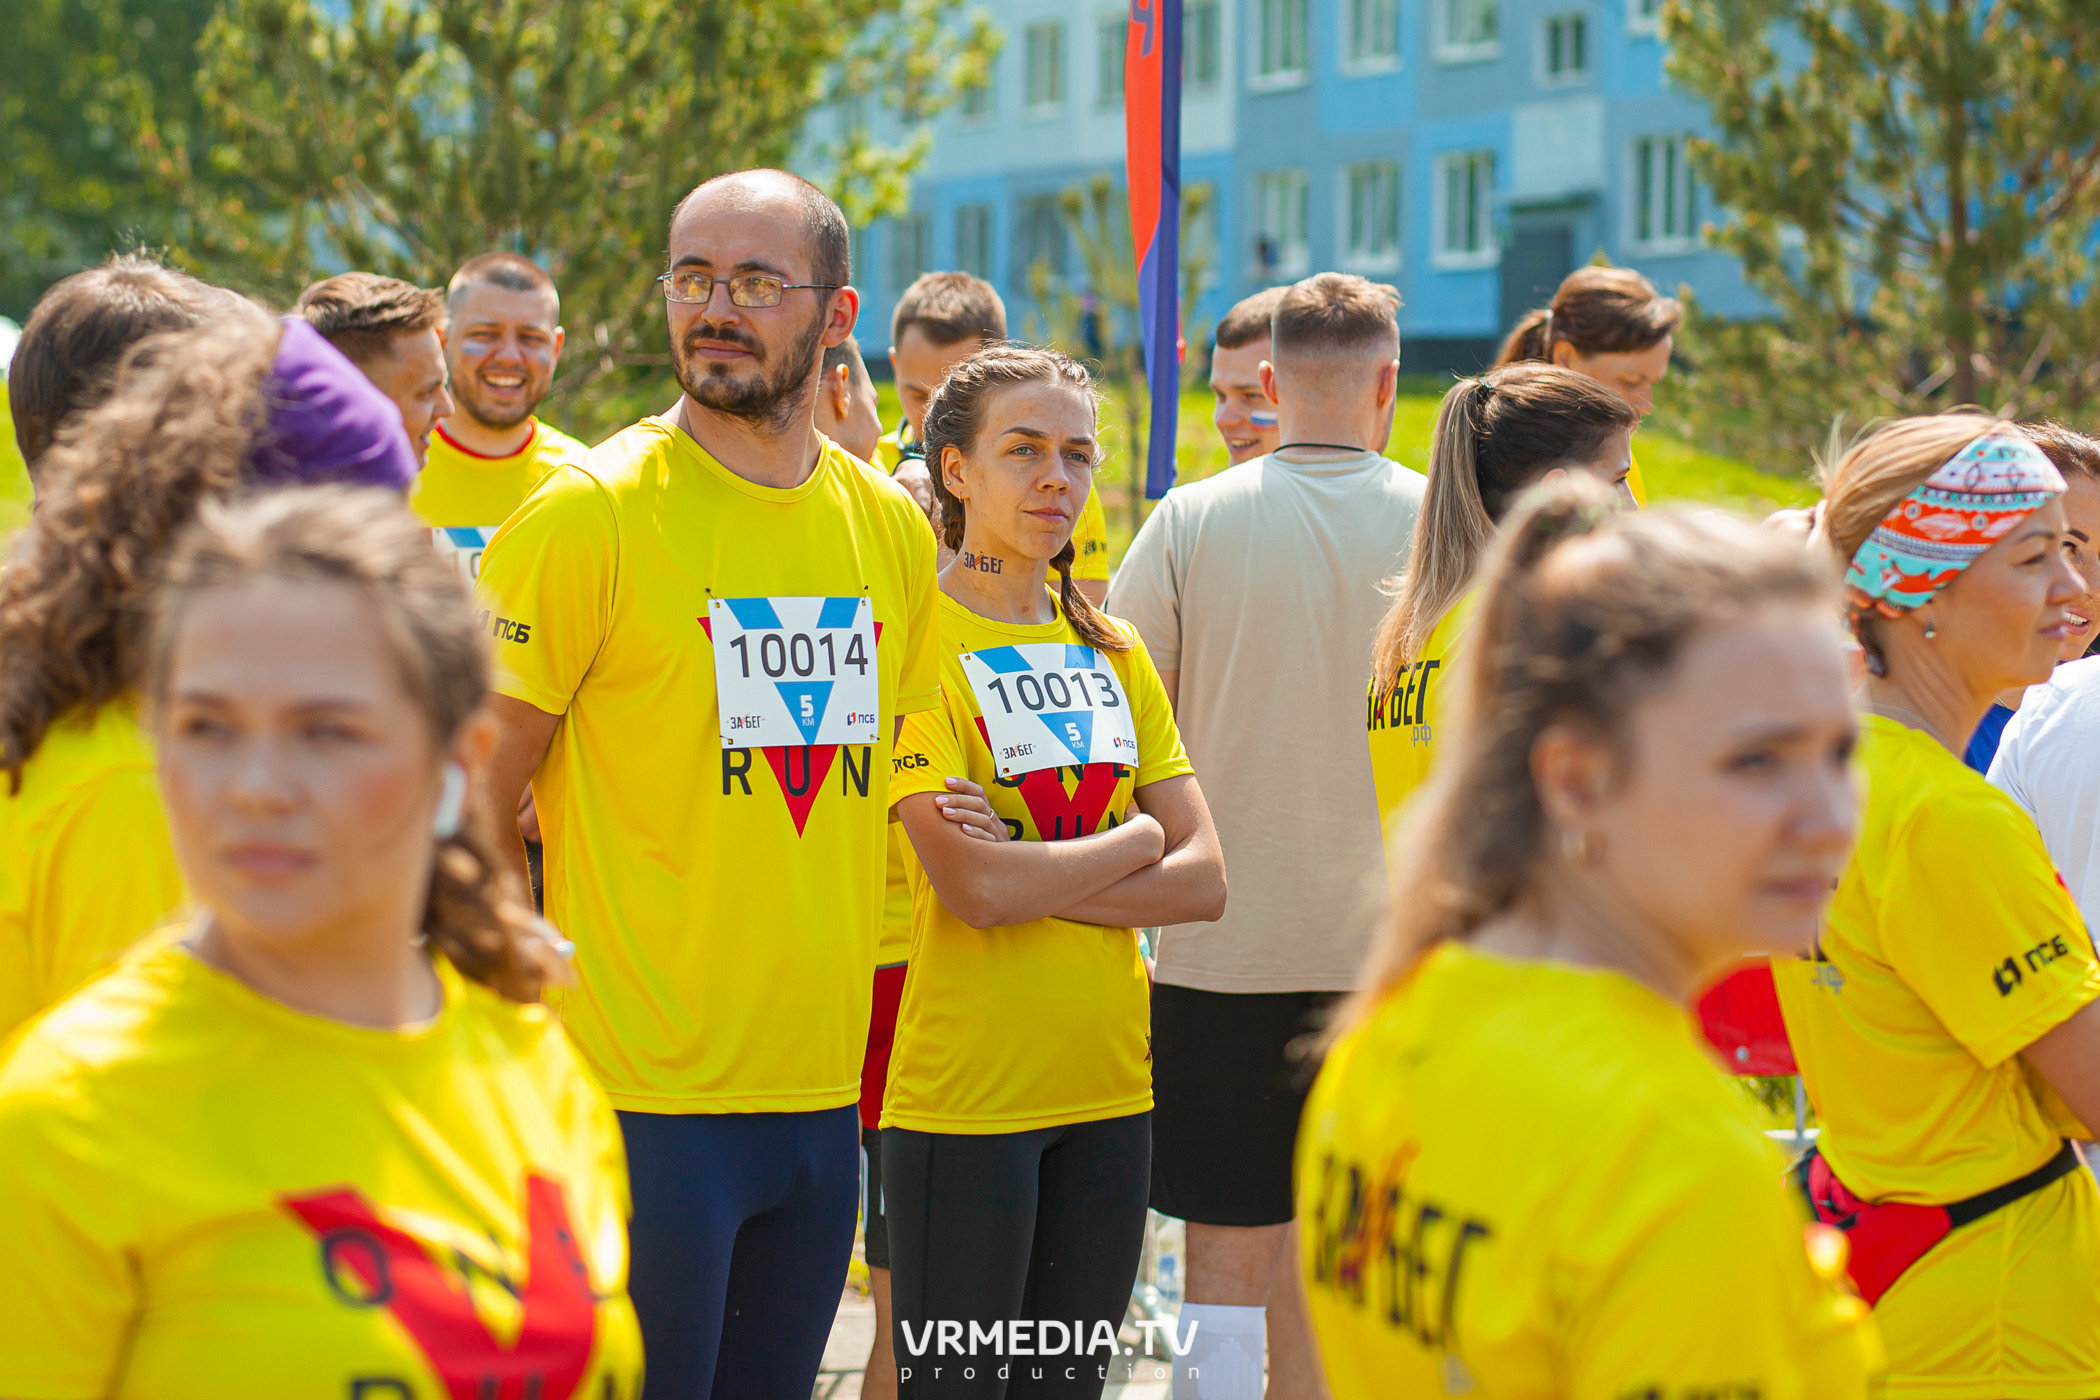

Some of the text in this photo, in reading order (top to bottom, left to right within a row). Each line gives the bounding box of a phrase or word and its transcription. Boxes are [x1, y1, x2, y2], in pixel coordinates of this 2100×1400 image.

[493, 617, 532, 644] ПСБ
[730, 633, 869, 679] 10014
[800, 694, 814, 717] 5
[987, 672, 1120, 714] 10013
[858, 714, 875, 724] ПСБ
[1064, 722, 1082, 742] 5
[722, 746, 872, 798] RUN
[892, 753, 930, 774] ПСБ
